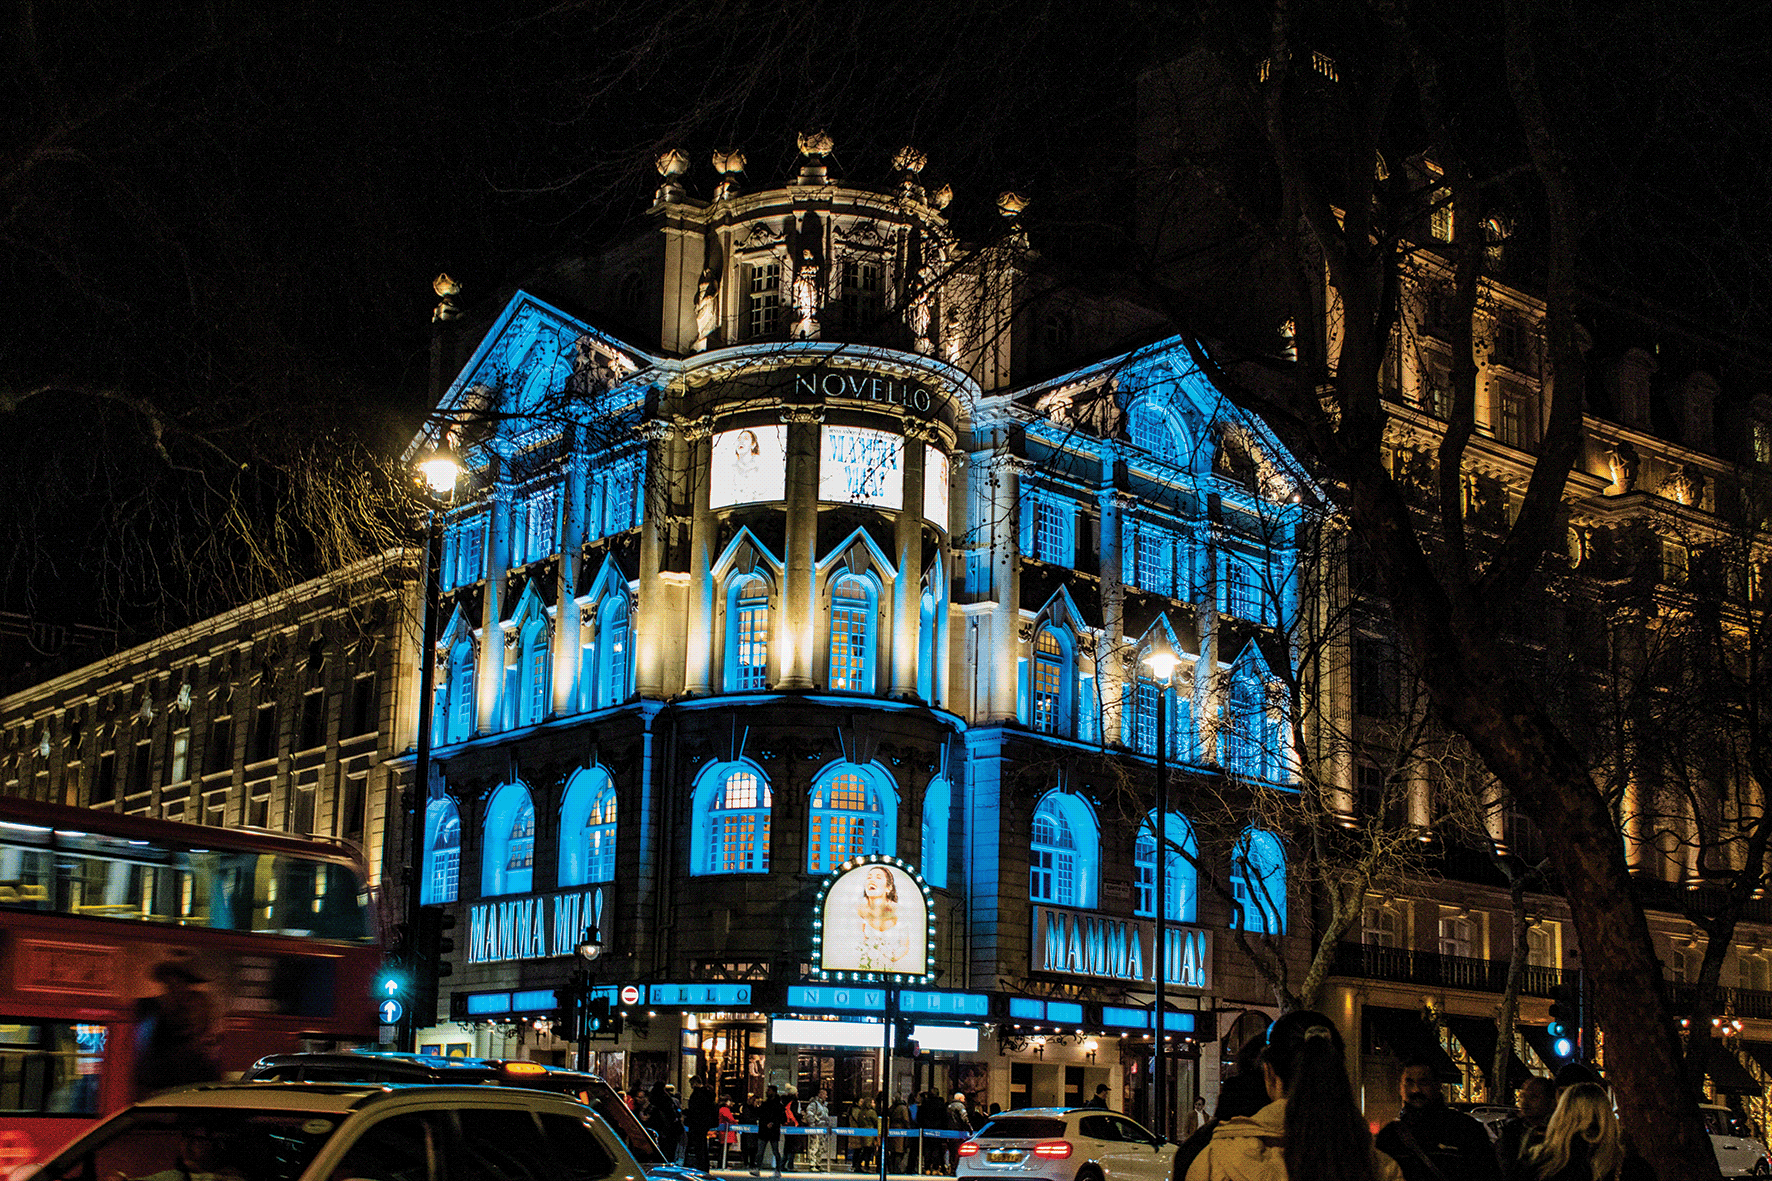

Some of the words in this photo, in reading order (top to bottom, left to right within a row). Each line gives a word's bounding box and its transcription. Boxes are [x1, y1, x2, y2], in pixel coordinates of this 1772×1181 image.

[795, 373, 931, 412] NOVELLO
[468, 897, 546, 963] MAMMA
[1043, 911, 1144, 982] MAMMA
